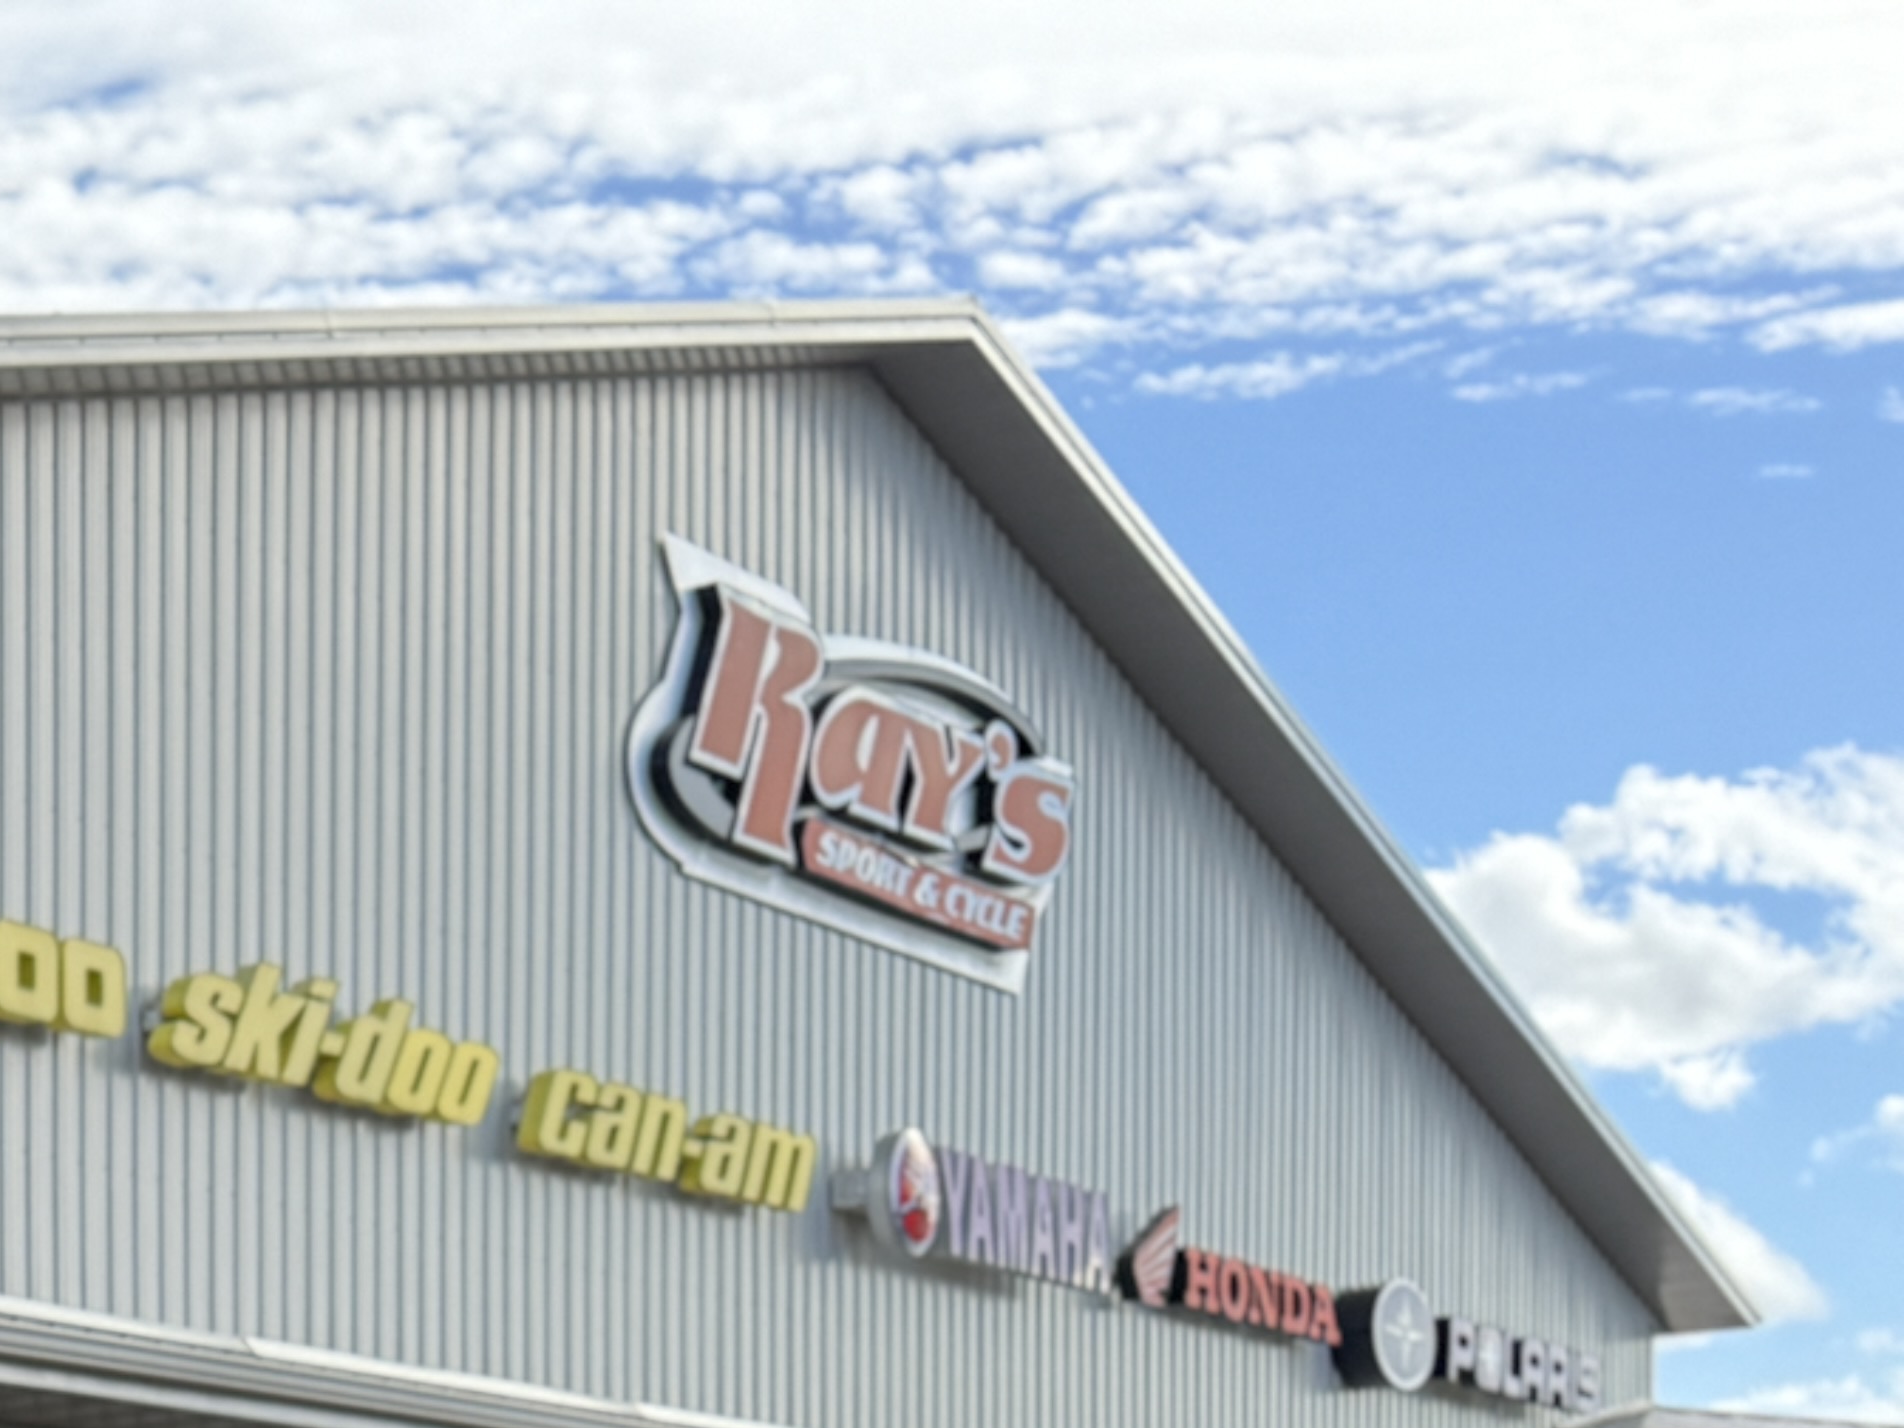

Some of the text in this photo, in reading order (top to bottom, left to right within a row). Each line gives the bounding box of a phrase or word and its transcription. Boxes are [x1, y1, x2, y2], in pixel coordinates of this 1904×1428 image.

[692, 588, 1076, 886] Ray's
[814, 829, 1029, 940] SPORT & CYCLE
[148, 962, 499, 1127] ski-doo
[941, 1145, 1112, 1295] YAMAHA
[1185, 1247, 1343, 1346] HONDA
[1448, 1315, 1601, 1412] POLARIS
